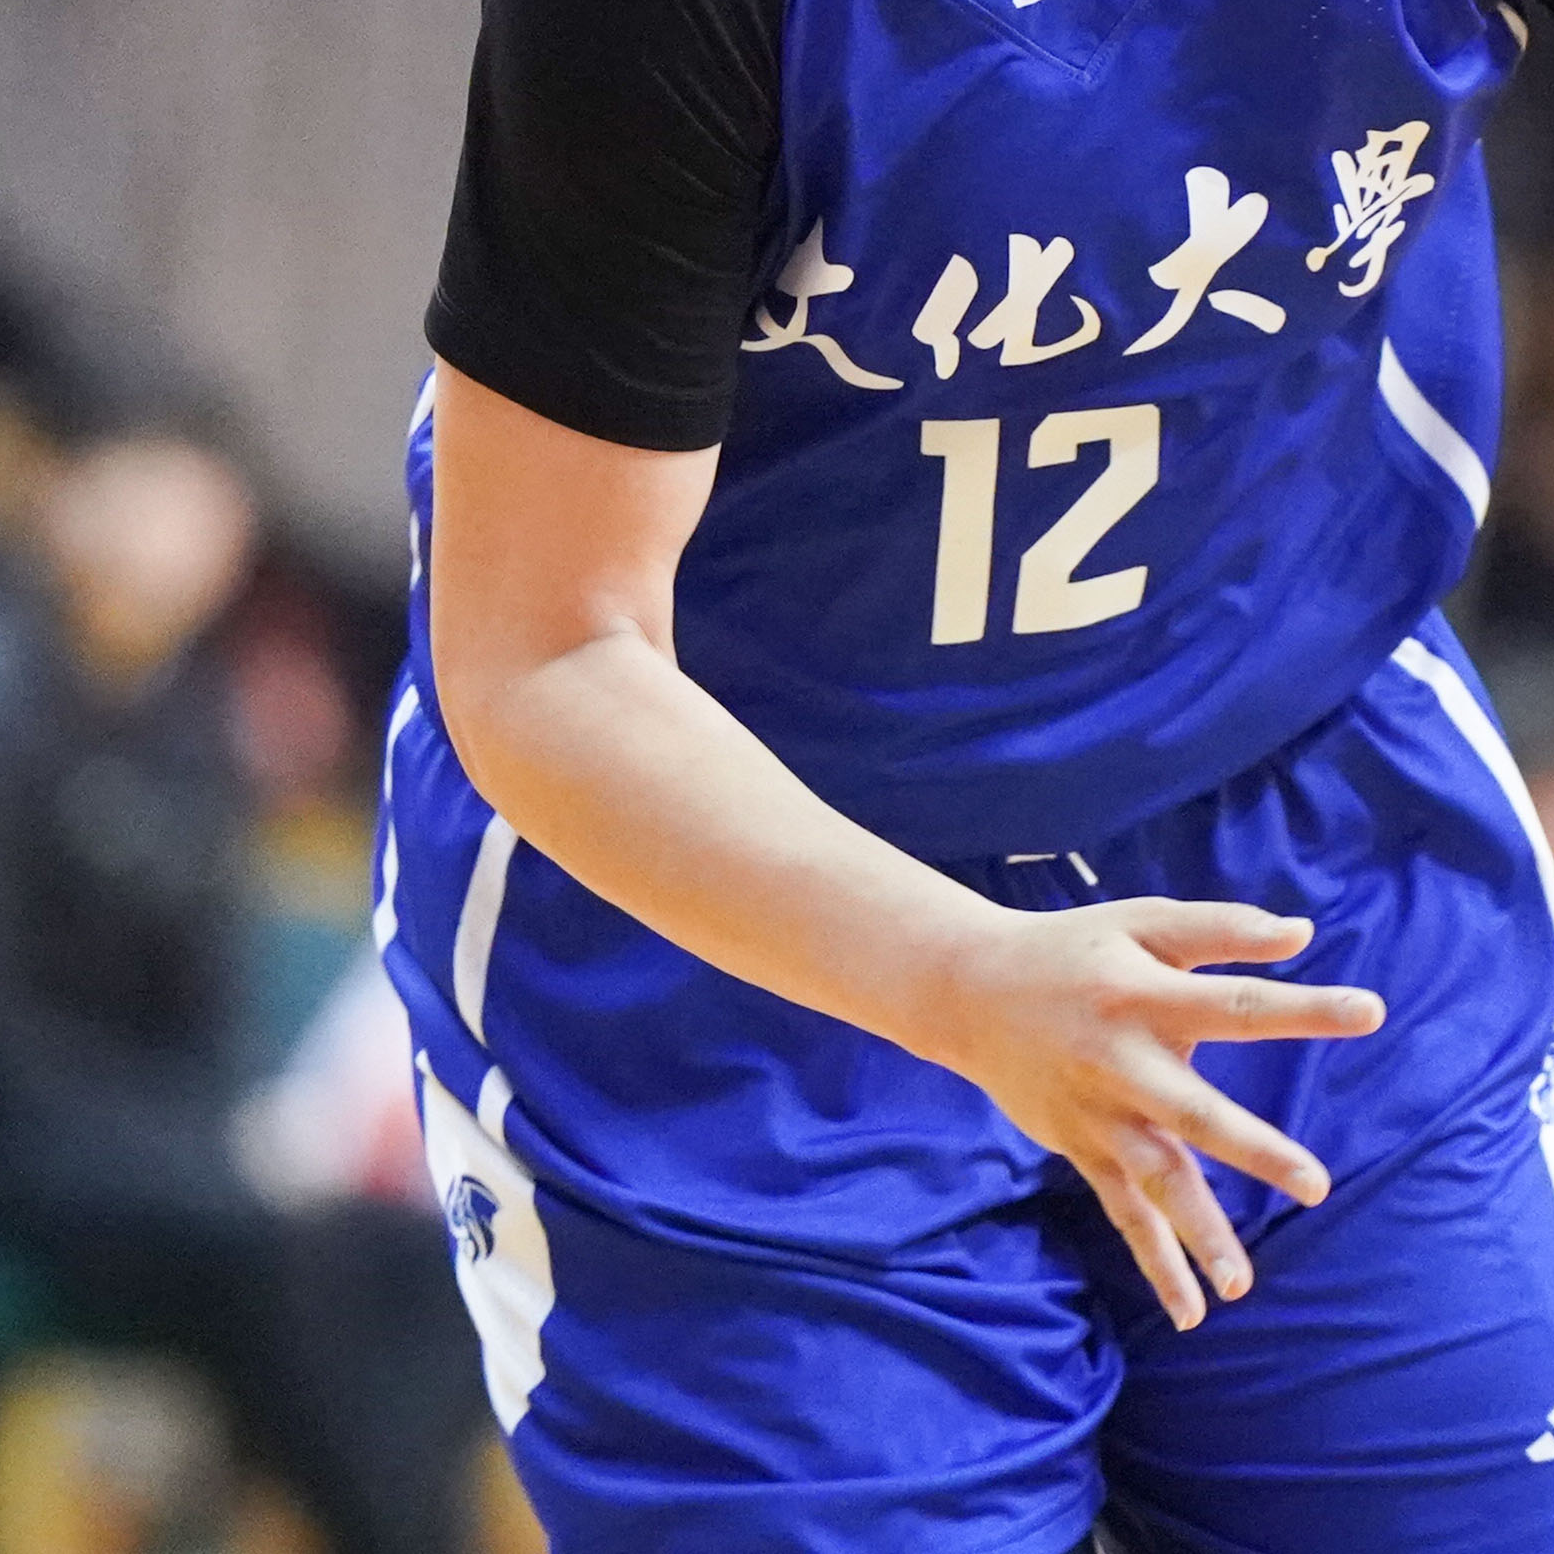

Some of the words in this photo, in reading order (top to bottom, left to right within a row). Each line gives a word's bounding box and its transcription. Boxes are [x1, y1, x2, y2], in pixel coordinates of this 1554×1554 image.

[740, 120, 1435, 391] 文化大學
[920, 402, 1161, 646] 12
